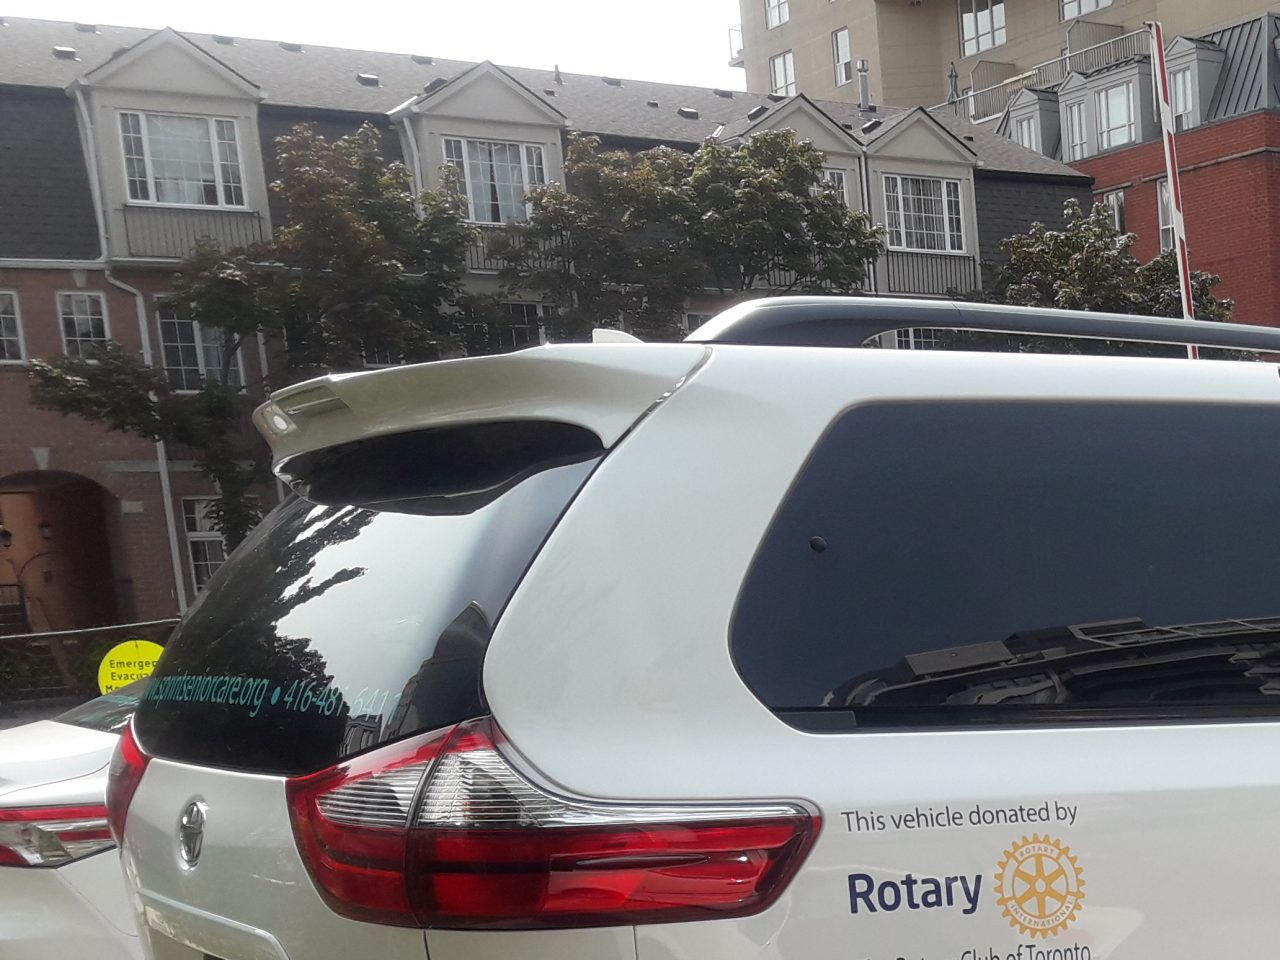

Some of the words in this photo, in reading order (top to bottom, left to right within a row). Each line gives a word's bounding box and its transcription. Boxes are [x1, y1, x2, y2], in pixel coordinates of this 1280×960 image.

[841, 810, 886, 832] This
[891, 806, 963, 830] vehicle
[968, 801, 1050, 826] donated
[1055, 800, 1078, 825] by
[1019, 845, 1055, 857] ROTARY
[848, 873, 982, 915] Rotary
[1010, 901, 1073, 928] INTERNATIONAL
